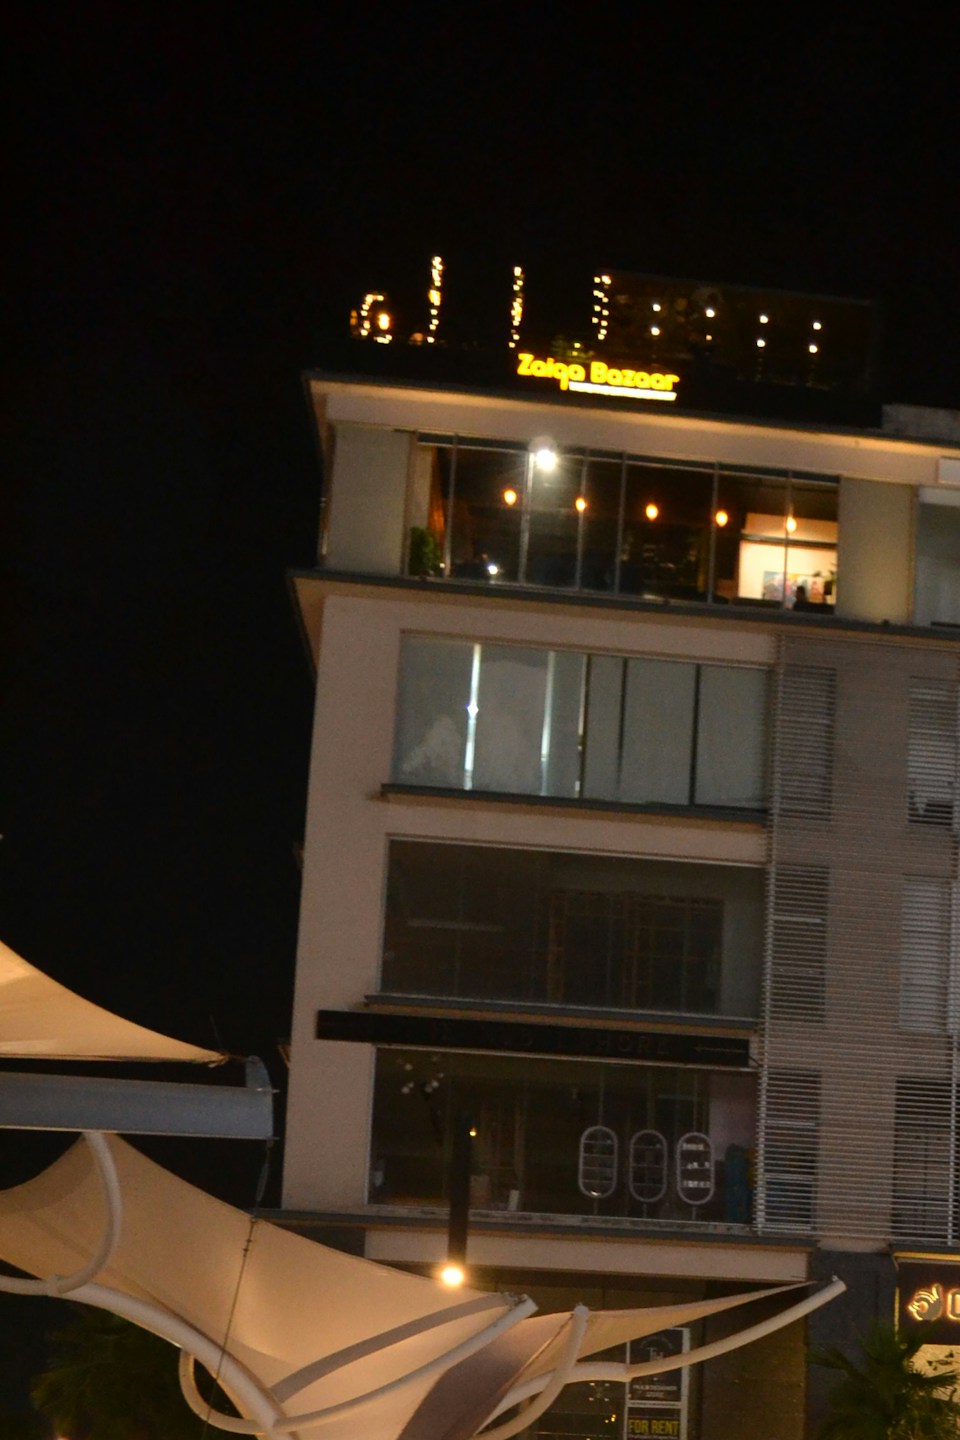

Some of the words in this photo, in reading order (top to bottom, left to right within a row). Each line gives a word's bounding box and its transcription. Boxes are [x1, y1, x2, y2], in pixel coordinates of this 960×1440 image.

[517, 353, 586, 391] Zaiqa
[590, 361, 680, 391] Bazaar
[628, 1419, 649, 1434] FOR
[651, 1420, 679, 1436] RENT
